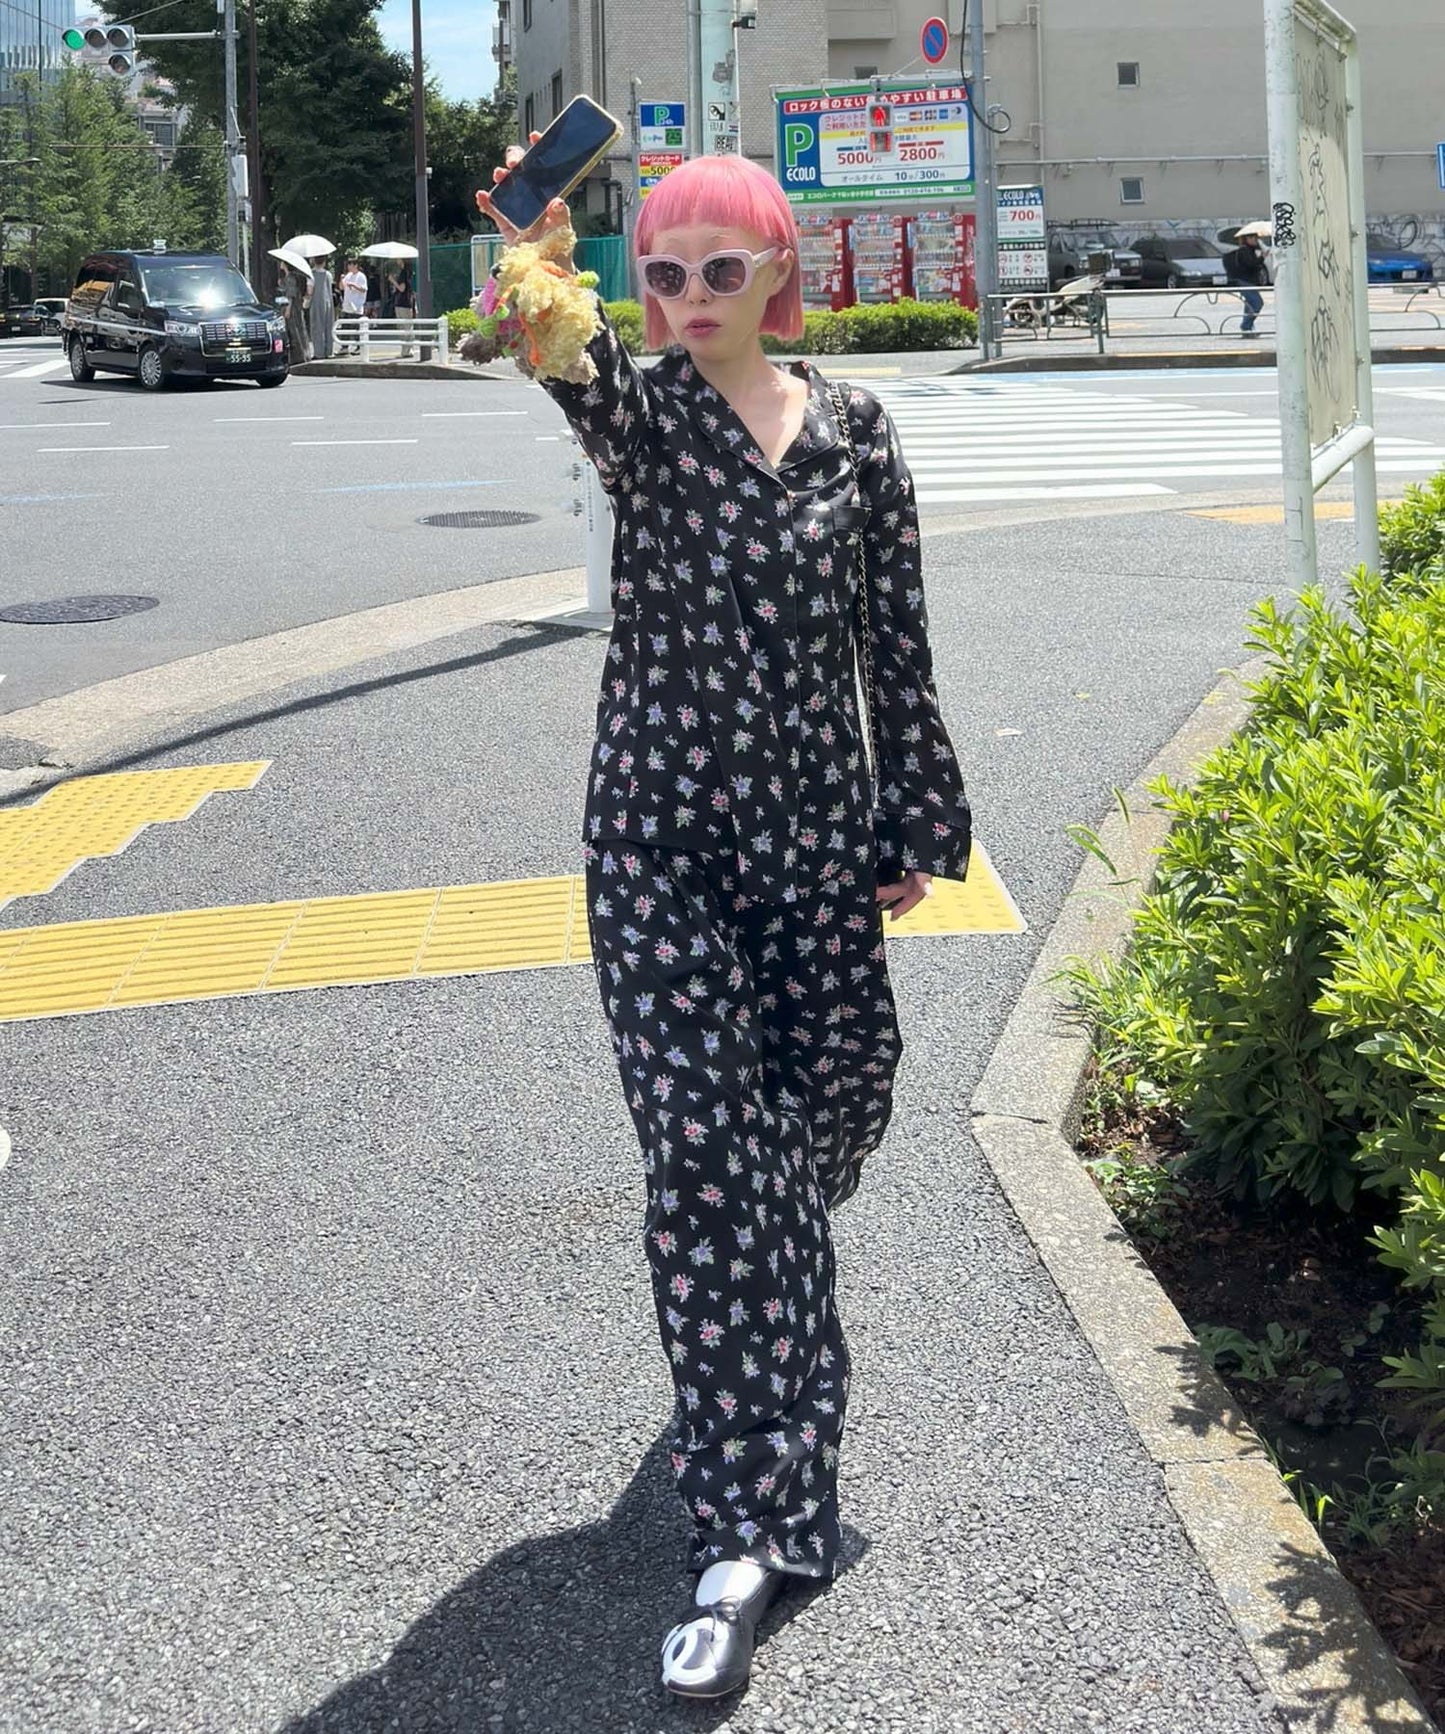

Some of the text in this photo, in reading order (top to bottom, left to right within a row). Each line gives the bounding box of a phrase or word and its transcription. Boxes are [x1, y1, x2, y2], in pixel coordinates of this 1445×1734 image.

[654, 106, 670, 126] P
[784, 123, 815, 168] P
[786, 166, 816, 182] ECOLO
